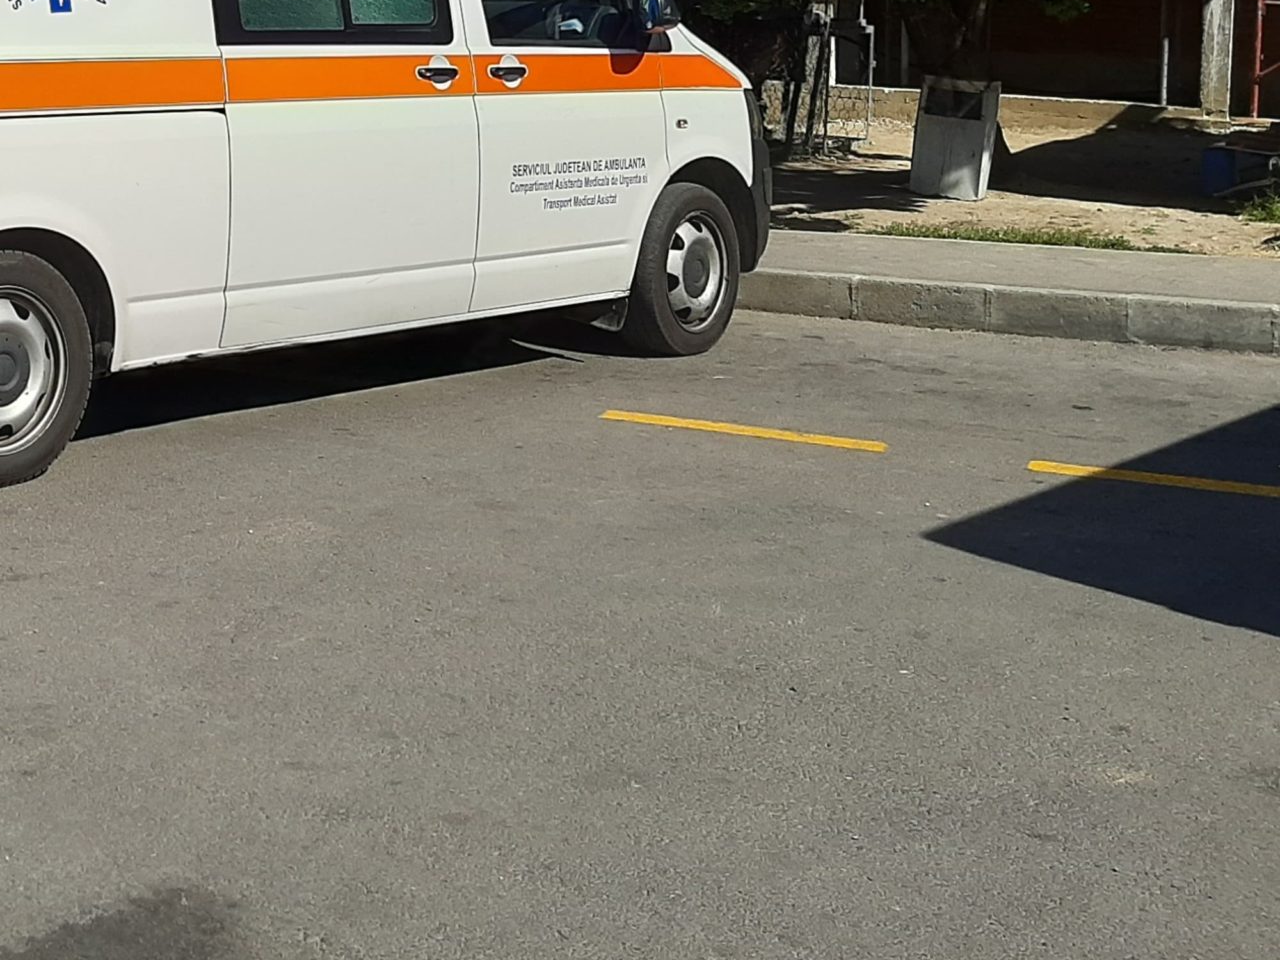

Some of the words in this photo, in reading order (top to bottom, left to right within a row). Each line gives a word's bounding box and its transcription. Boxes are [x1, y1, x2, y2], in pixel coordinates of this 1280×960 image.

[512, 163, 552, 177] SERVICIUL
[553, 160, 591, 174] JUDETEAN
[593, 159, 603, 172] DE
[604, 157, 646, 171] AMBULANTA
[510, 180, 554, 194] Compartiment
[543, 197, 573, 211] Transport
